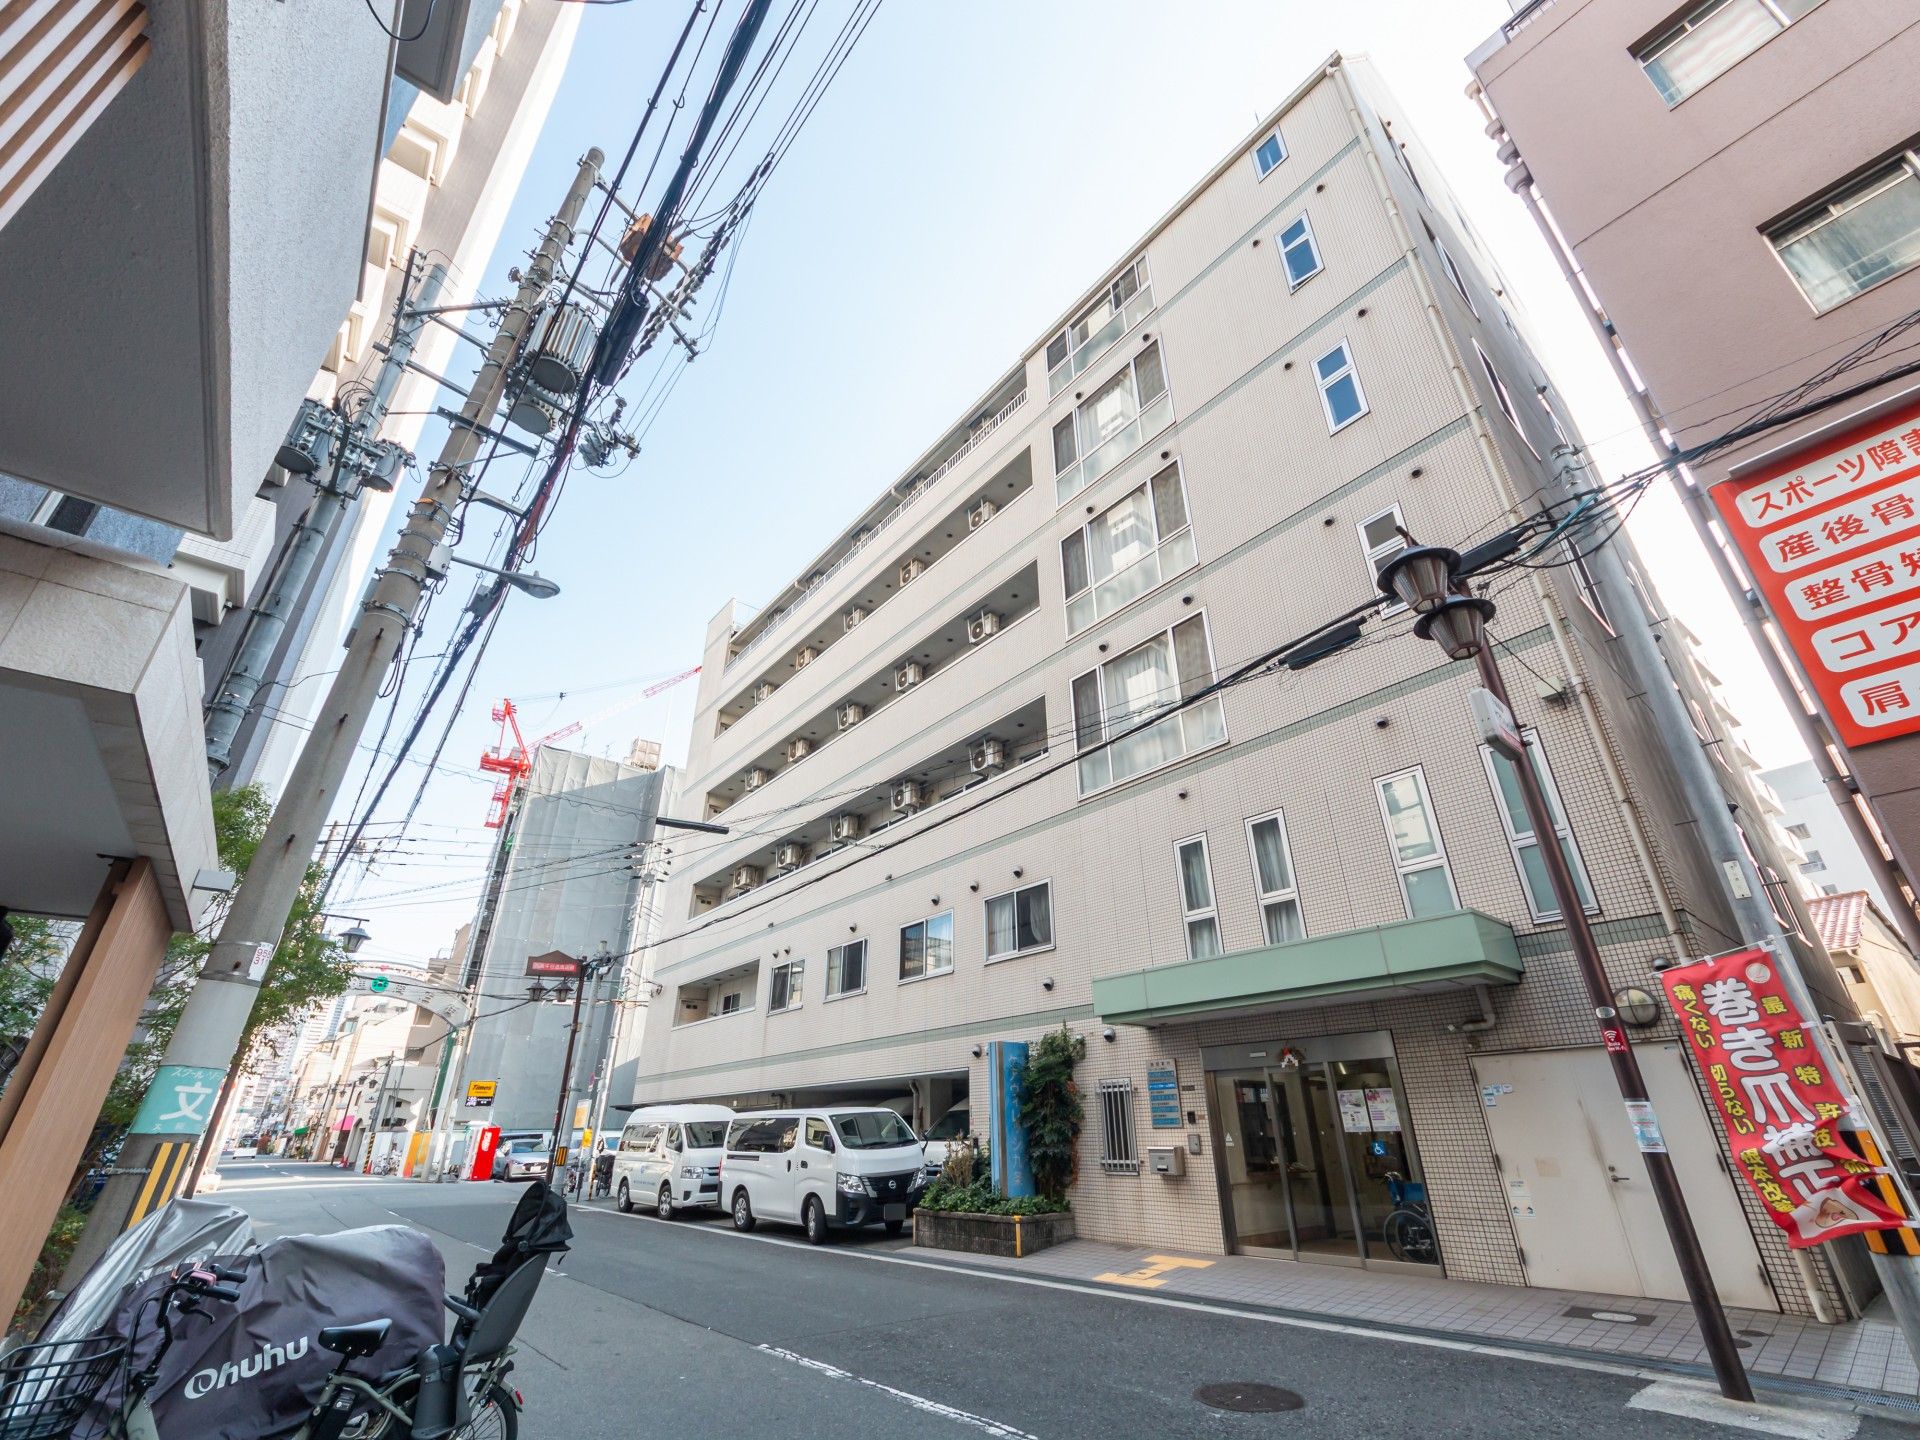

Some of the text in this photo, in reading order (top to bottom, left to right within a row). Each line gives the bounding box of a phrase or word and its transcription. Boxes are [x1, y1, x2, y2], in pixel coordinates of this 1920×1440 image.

[1775, 493, 1915, 563] 産後骨
[1830, 610, 1920, 662] コア
[1858, 680, 1911, 716] 肩
[1672, 984, 1716, 1050] 痛くない
[159, 1081, 213, 1121] 文
[1709, 1063, 1755, 1135] 切らない
[184, 1336, 308, 1400] Ohuhu
